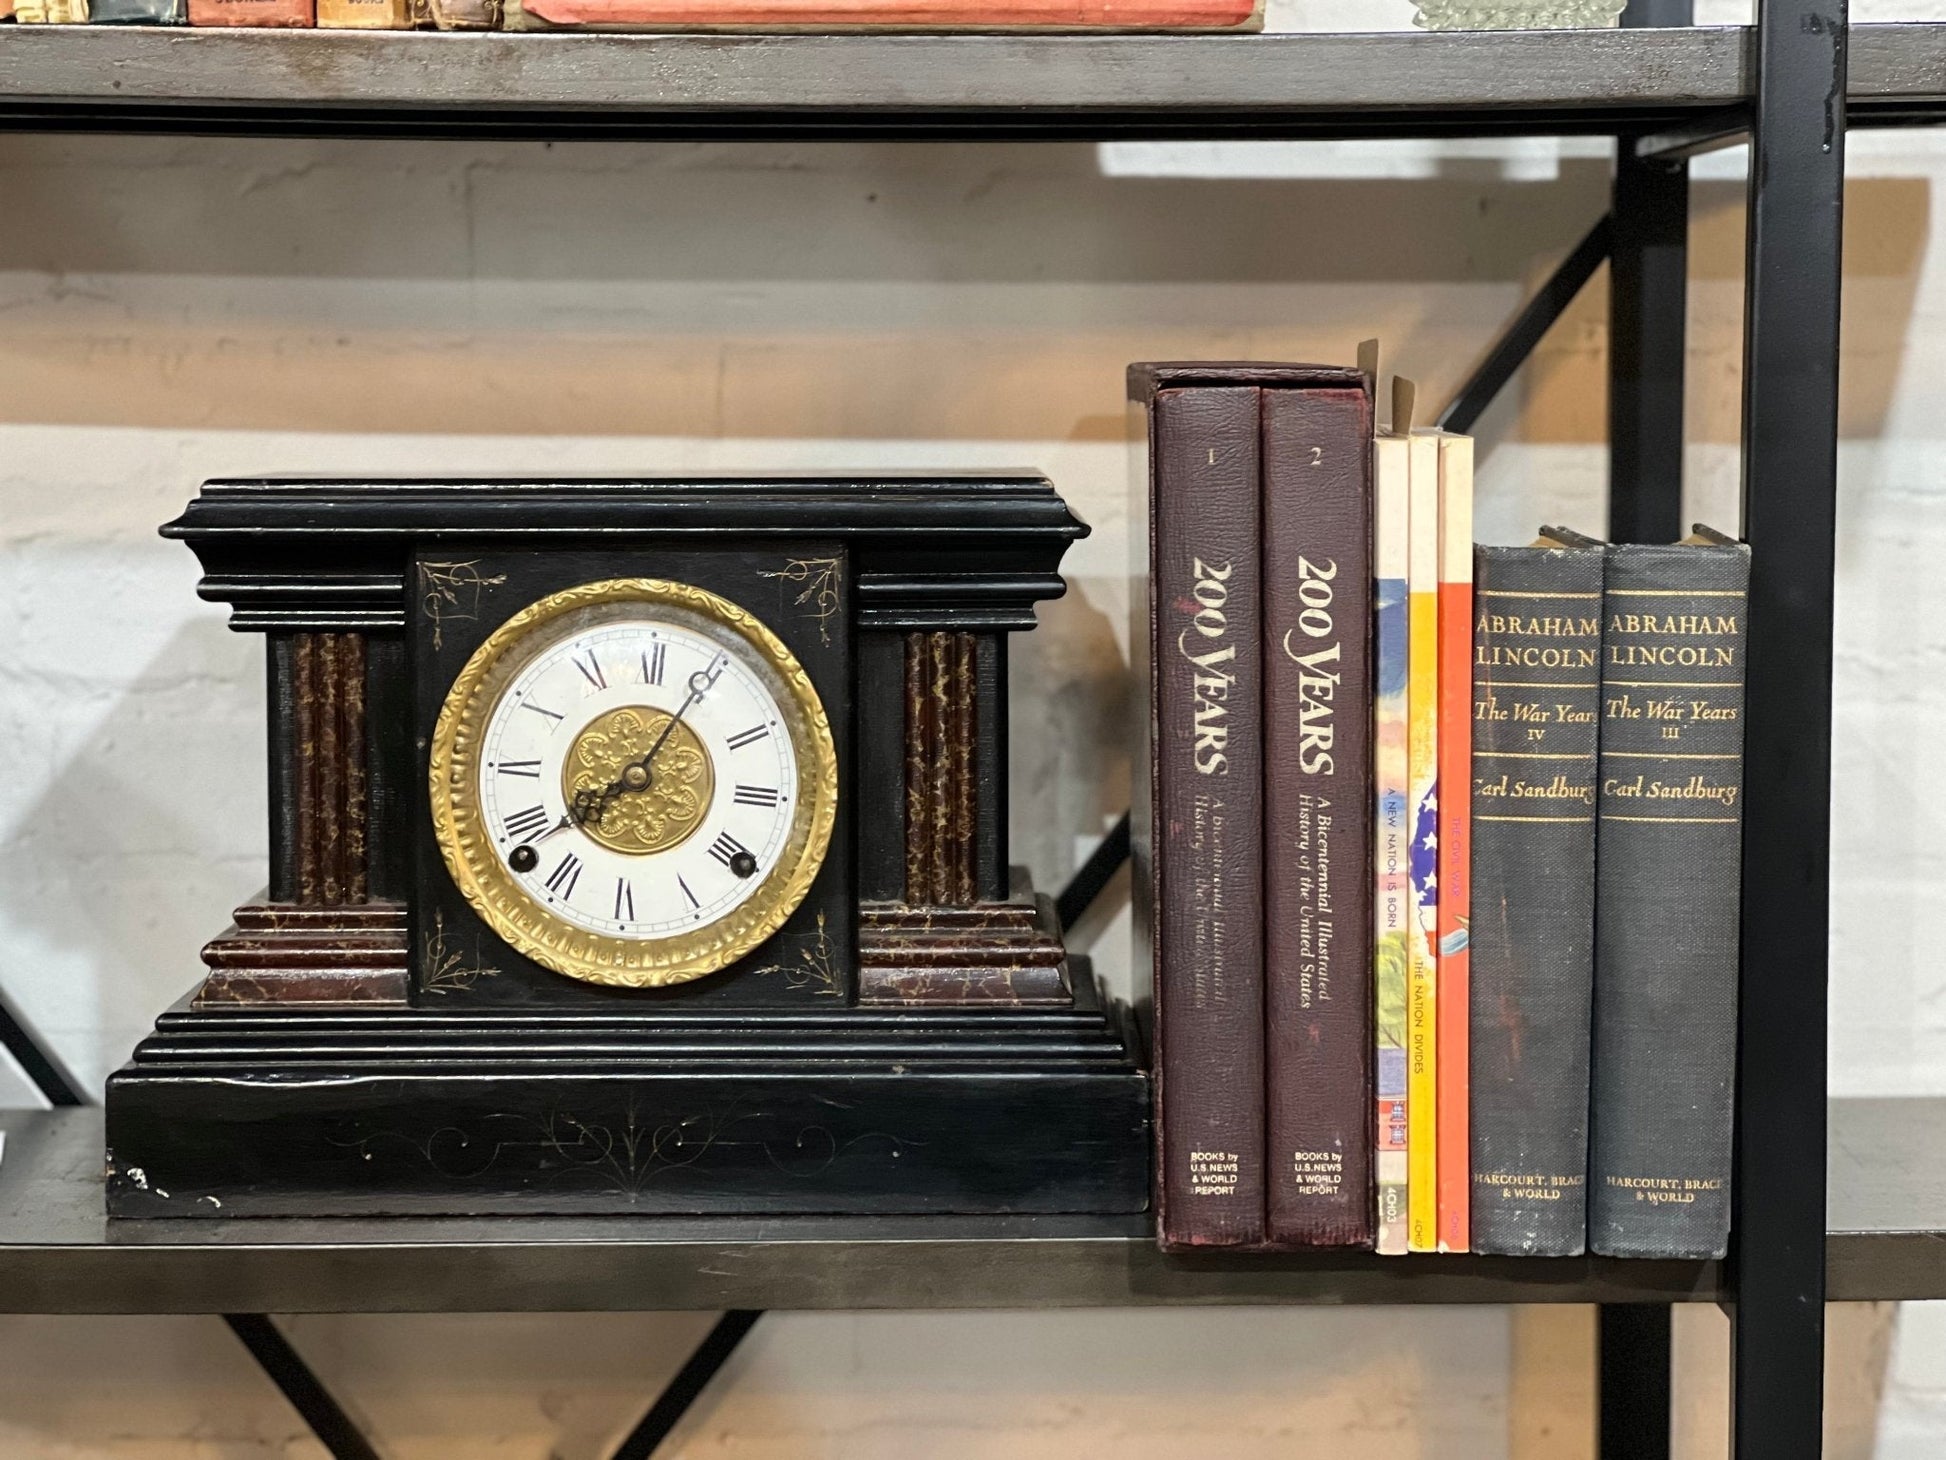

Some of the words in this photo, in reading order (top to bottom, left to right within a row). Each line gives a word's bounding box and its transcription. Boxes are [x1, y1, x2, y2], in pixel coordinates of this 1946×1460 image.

[1207, 448, 1216, 466] 1
[1310, 447, 1323, 466] 2
[1193, 556, 1233, 638] 200
[1298, 555, 1338, 638] 200
[1476, 614, 1600, 636] ABRAHAM
[1608, 614, 1738, 635] ABRAHAM
[635, 642, 667, 686] XII
[1477, 646, 1597, 668] LINCOLN
[1611, 646, 1735, 667] LINCOLN
[571, 647, 612, 699] XI
[521, 692, 565, 735] X
[1475, 697, 1508, 721] The
[1513, 703, 1550, 723] War
[1606, 695, 1641, 719] The
[1646, 700, 1684, 720] War
[1689, 700, 1738, 720] Years
[725, 722, 770, 751] II
[1527, 728, 1545, 741] IV
[1661, 727, 1680, 739] III
[497, 757, 542, 778] IX
[733, 783, 779, 809] III
[1317, 796, 1331, 809] A
[1387, 787, 1396, 796] A
[1604, 776, 1643, 798] Carl
[1646, 776, 1739, 806] Sandburg
[1295, 793, 1313, 850] History
[1387, 801, 1397, 828] NEW
[1451, 817, 1461, 838] THE
[1295, 855, 1314, 873] of
[1317, 814, 1332, 914] Bicentennial
[1387, 833, 1397, 876] NATION
[544, 851, 584, 902] VII
[1387, 882, 1397, 892] IS
[1450, 871, 1461, 898] WAR
[1299, 877, 1314, 901] the
[1387, 897, 1397, 928] BORN
[1299, 905, 1314, 958] United
[1317, 920, 1332, 1001] Illustrated
[1414, 960, 1424, 980] THE
[1299, 963, 1314, 1009] States
[1413, 985, 1424, 1028] NATION
[1413, 1034, 1424, 1074] DIVIDES
[1190, 1152, 1225, 1162] BOOKS
[1227, 1152, 1239, 1164] by
[1295, 1152, 1330, 1162] BOOKS
[1331, 1152, 1343, 1164] by
[1191, 1174, 1200, 1184] &
[1201, 1174, 1238, 1184] WORLD
[1194, 1186, 1235, 1196] REPORT
[1295, 1174, 1303, 1184] &
[1304, 1174, 1342, 1184] WORLD
[1298, 1186, 1340, 1196] REPORT
[1386, 1186, 1397, 1223] 4CH03
[1502, 1189, 1511, 1200] &
[1514, 1188, 1561, 1200] WORLD
[1636, 1191, 1645, 1201] &
[1647, 1191, 1695, 1204] WORLD
